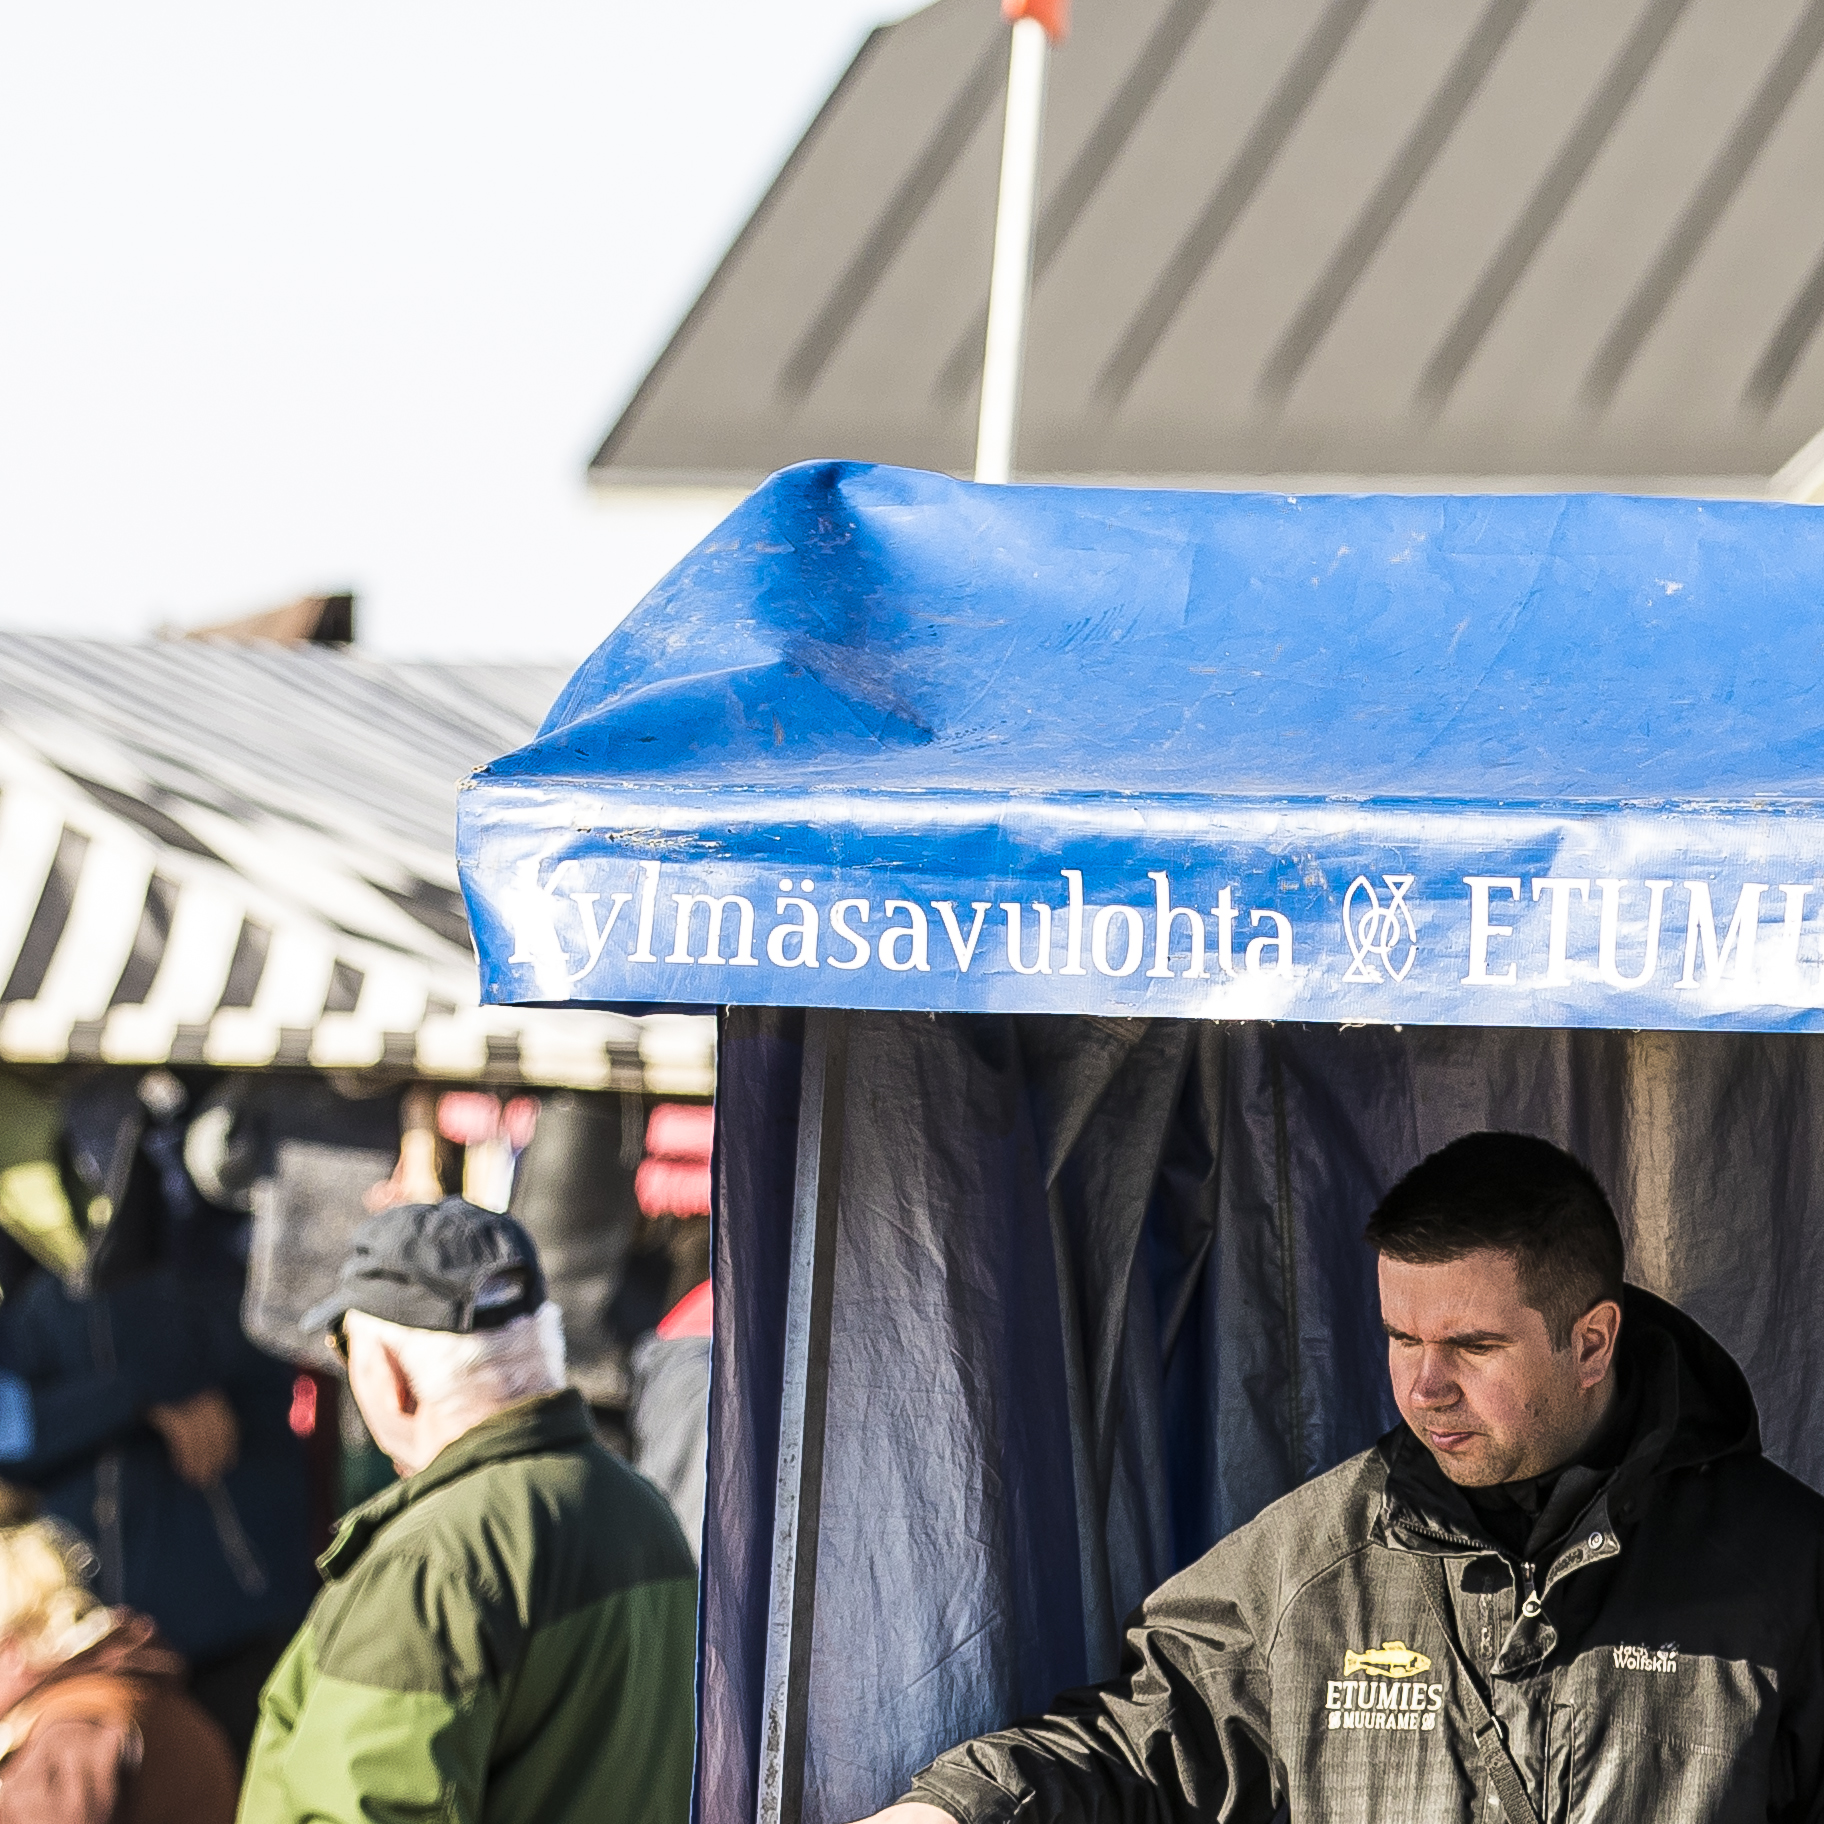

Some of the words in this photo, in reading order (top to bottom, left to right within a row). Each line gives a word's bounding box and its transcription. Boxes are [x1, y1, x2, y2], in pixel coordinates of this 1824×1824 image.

[1613, 1651, 1677, 1673] Wolfskin
[1324, 1680, 1443, 1711] ETUMIES
[1342, 1711, 1418, 1730] MUURAME
